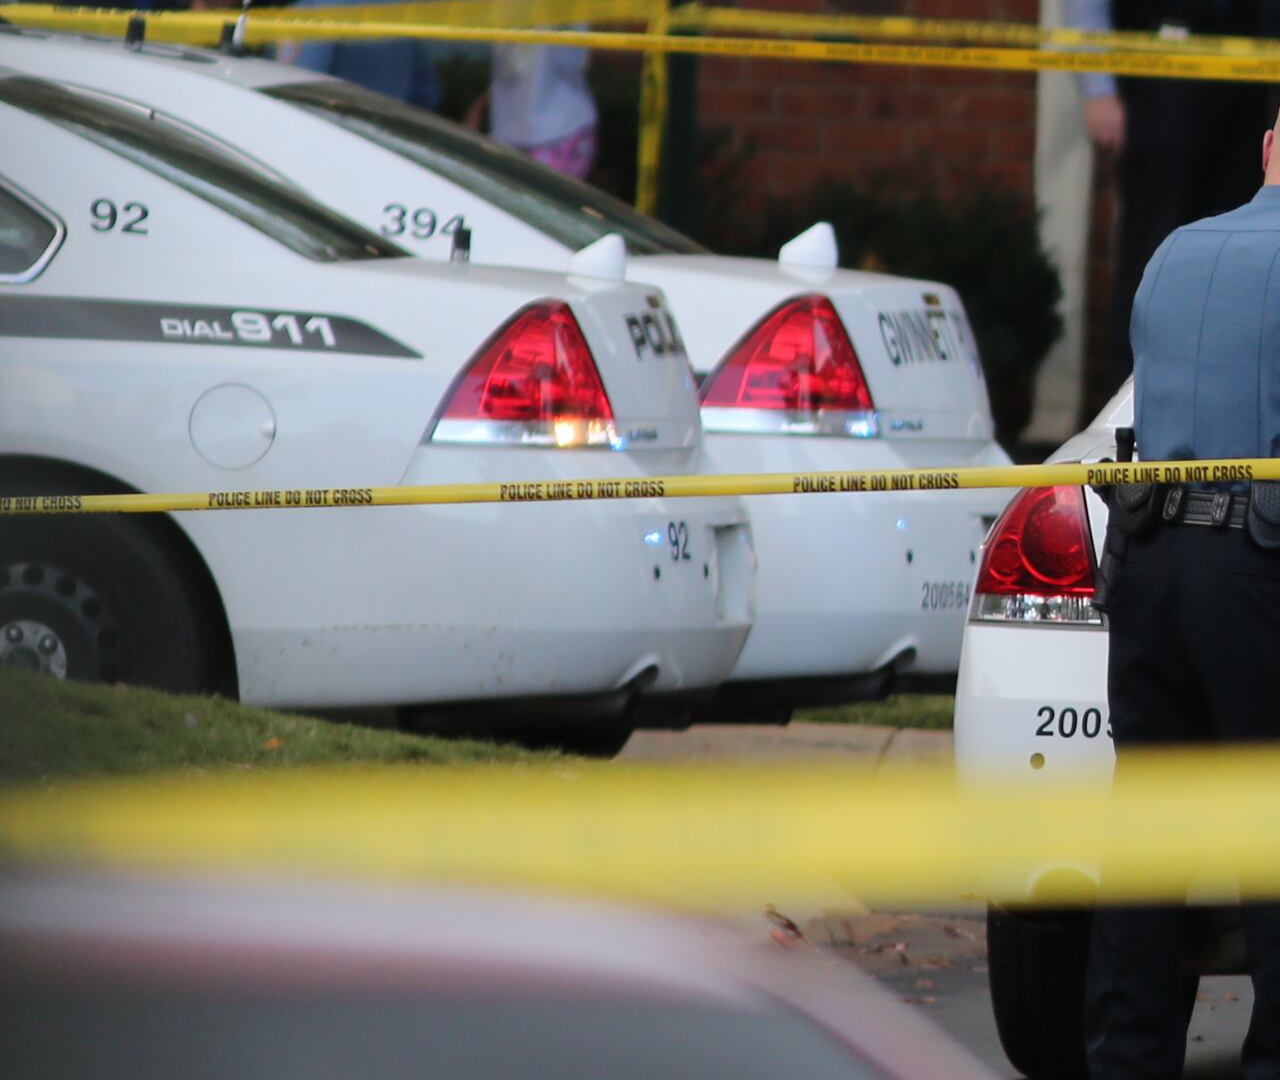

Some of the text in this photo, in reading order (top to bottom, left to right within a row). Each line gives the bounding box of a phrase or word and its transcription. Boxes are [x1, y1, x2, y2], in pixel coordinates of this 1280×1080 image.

[90, 199, 149, 234] 92
[382, 204, 465, 239] 394
[160, 311, 336, 347] DIAL 911
[793, 473, 959, 493] POLICE LINE DO NOT CROSS
[1087, 464, 1253, 485] POLICE LINE DO NOT CROSS
[208, 488, 373, 507] POLICE LINE DO NOT CROSS
[500, 480, 665, 500] POLICE LINE DO NOT CROSS
[668, 521, 691, 562] 92
